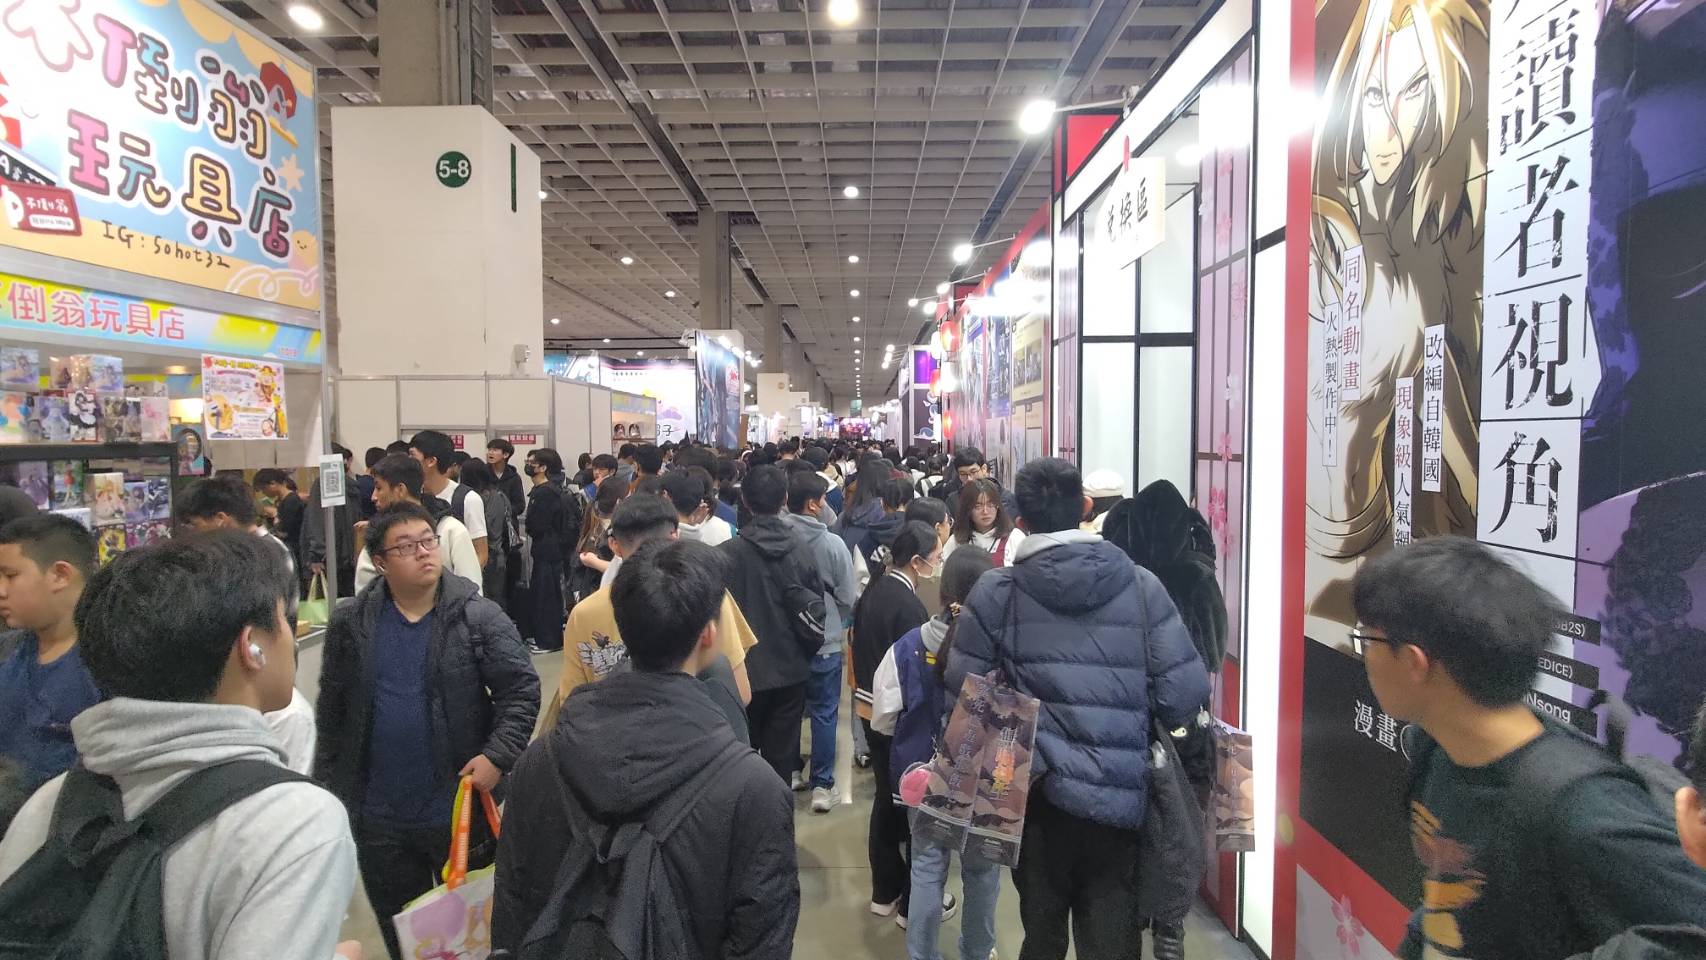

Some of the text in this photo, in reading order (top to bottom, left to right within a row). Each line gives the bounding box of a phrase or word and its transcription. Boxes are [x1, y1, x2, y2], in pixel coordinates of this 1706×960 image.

[67, 109, 293, 258] 玩具店
[439, 159, 470, 179] 5-8
[0, 282, 185, 341] 倒翁玩具店
[1490, 0, 1581, 543] 讀者視角
[1343, 254, 1361, 391] 同名動畫
[1423, 333, 1443, 484] 改編自韓國
[1526, 692, 1571, 723] Nsong
[1538, 657, 1573, 679] EDICE)
